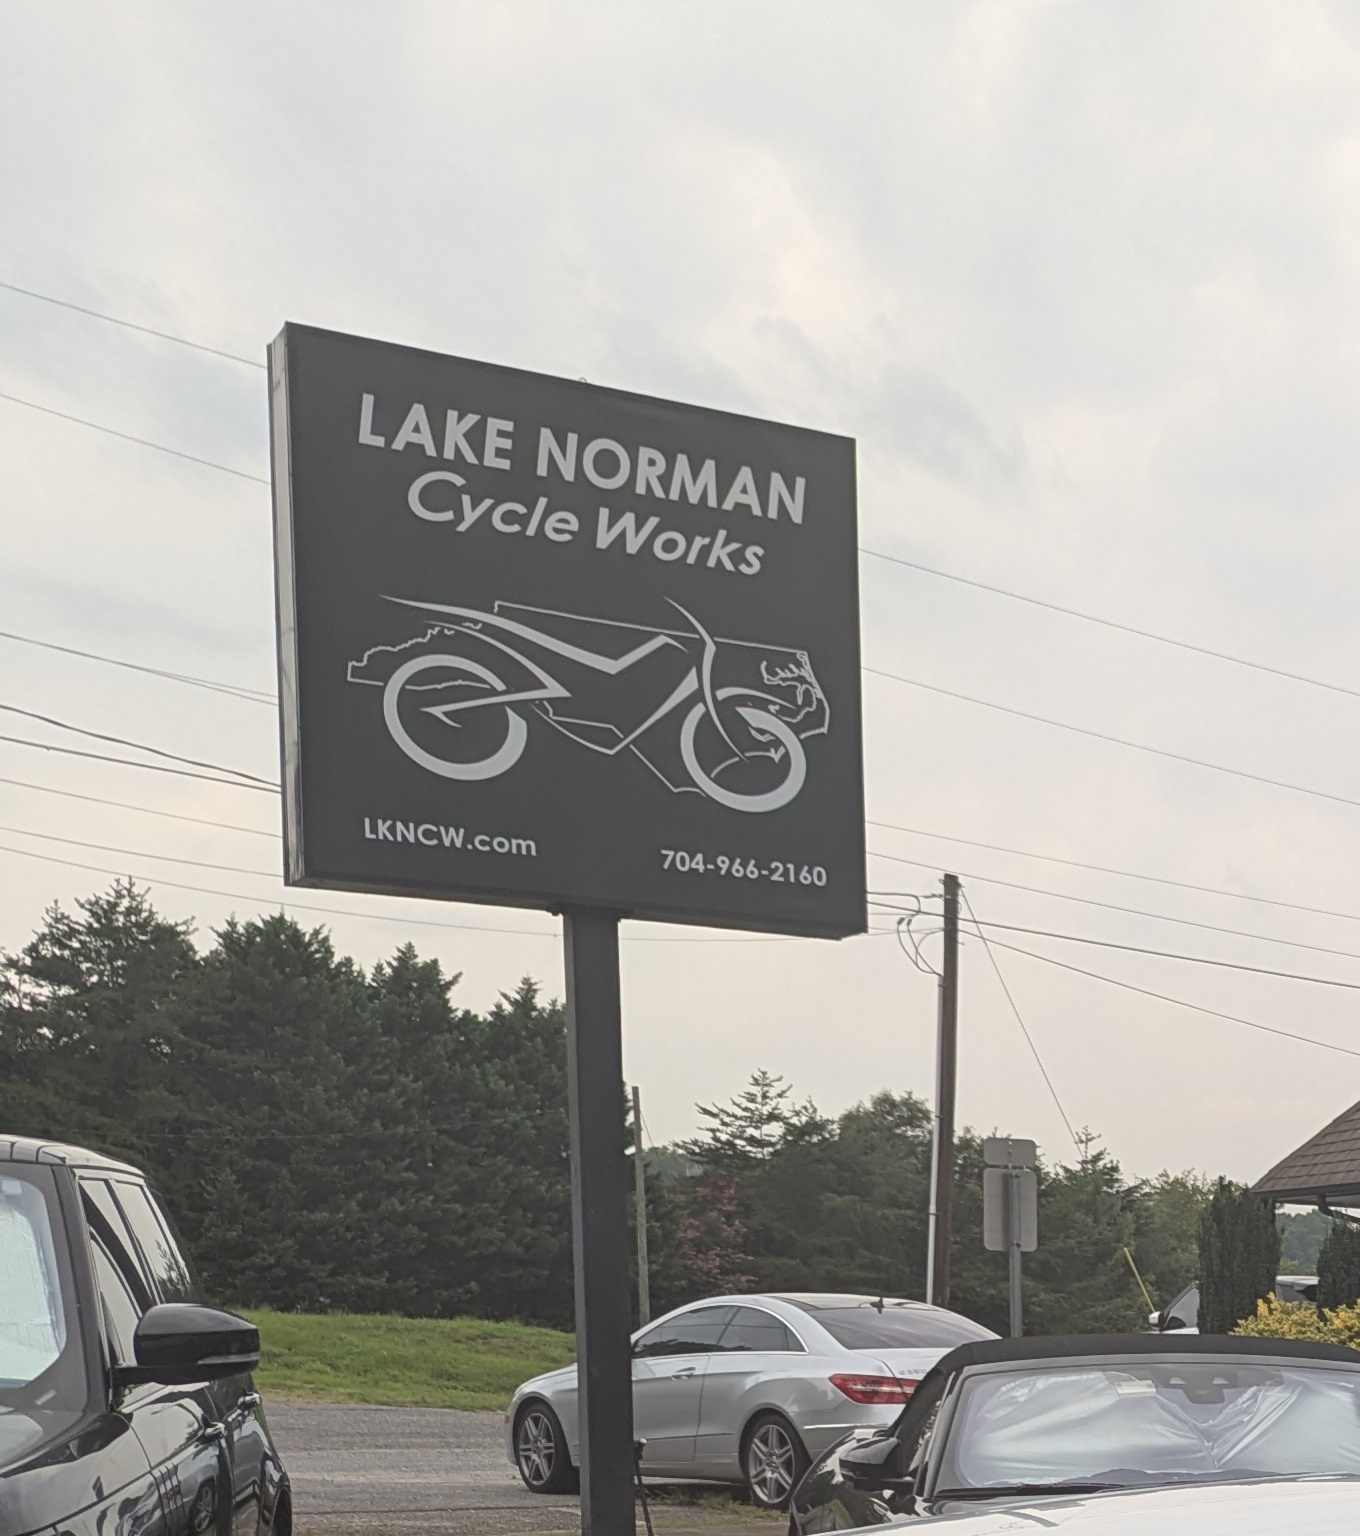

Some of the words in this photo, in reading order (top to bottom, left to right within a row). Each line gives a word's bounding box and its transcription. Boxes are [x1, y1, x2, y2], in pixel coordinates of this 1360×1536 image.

[358, 393, 514, 471] LAKE
[536, 426, 806, 524] NORMAN
[407, 471, 580, 542] Cycle
[595, 506, 765, 576] Works
[363, 817, 538, 857] LKNCW.com
[660, 849, 828, 887] 704-966-2160
